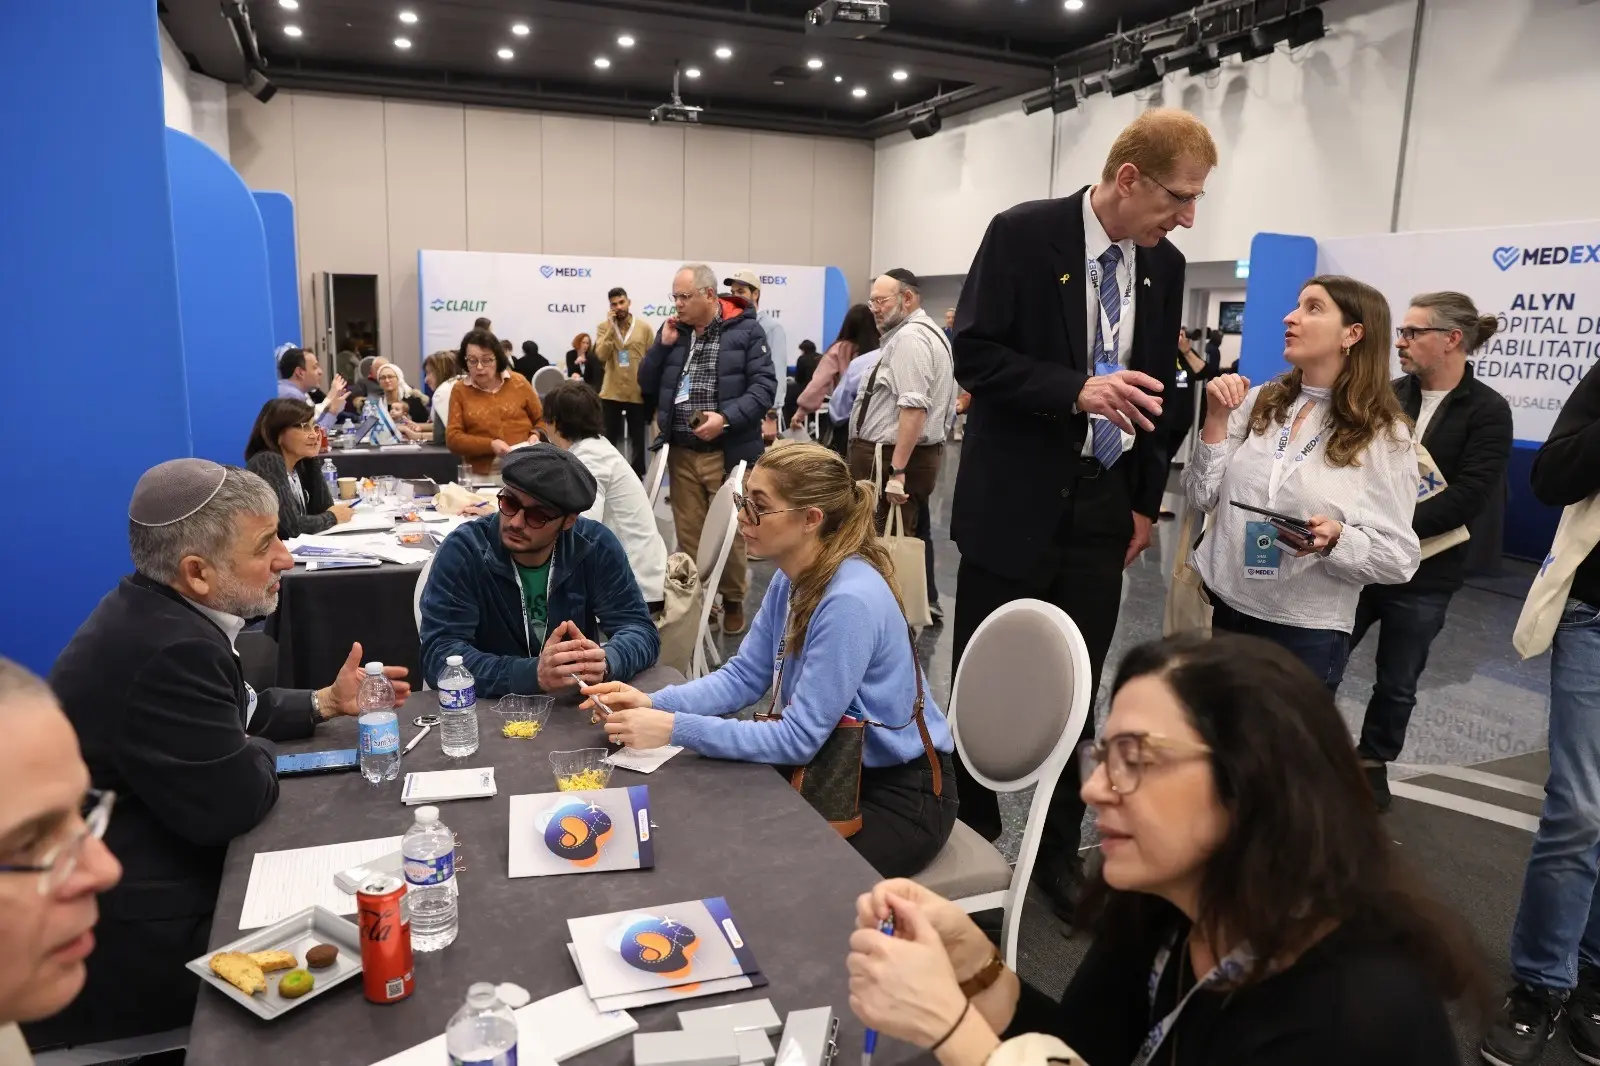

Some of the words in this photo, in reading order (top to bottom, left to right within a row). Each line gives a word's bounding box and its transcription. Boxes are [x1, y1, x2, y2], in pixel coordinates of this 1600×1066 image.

[1521, 244, 1600, 266] MEDEX
[555, 267, 592, 278] MEDEX
[1087, 258, 1099, 289] MEDEX
[446, 300, 488, 312] CLALIT
[547, 303, 586, 313] CLALIT
[656, 305, 679, 317] CLA
[1510, 293, 1576, 311] ALYN
[1496, 312, 1568, 334] ÔPITAL
[1277, 426, 1291, 452] MEDEX
[1300, 435, 1321, 457] MEDE
